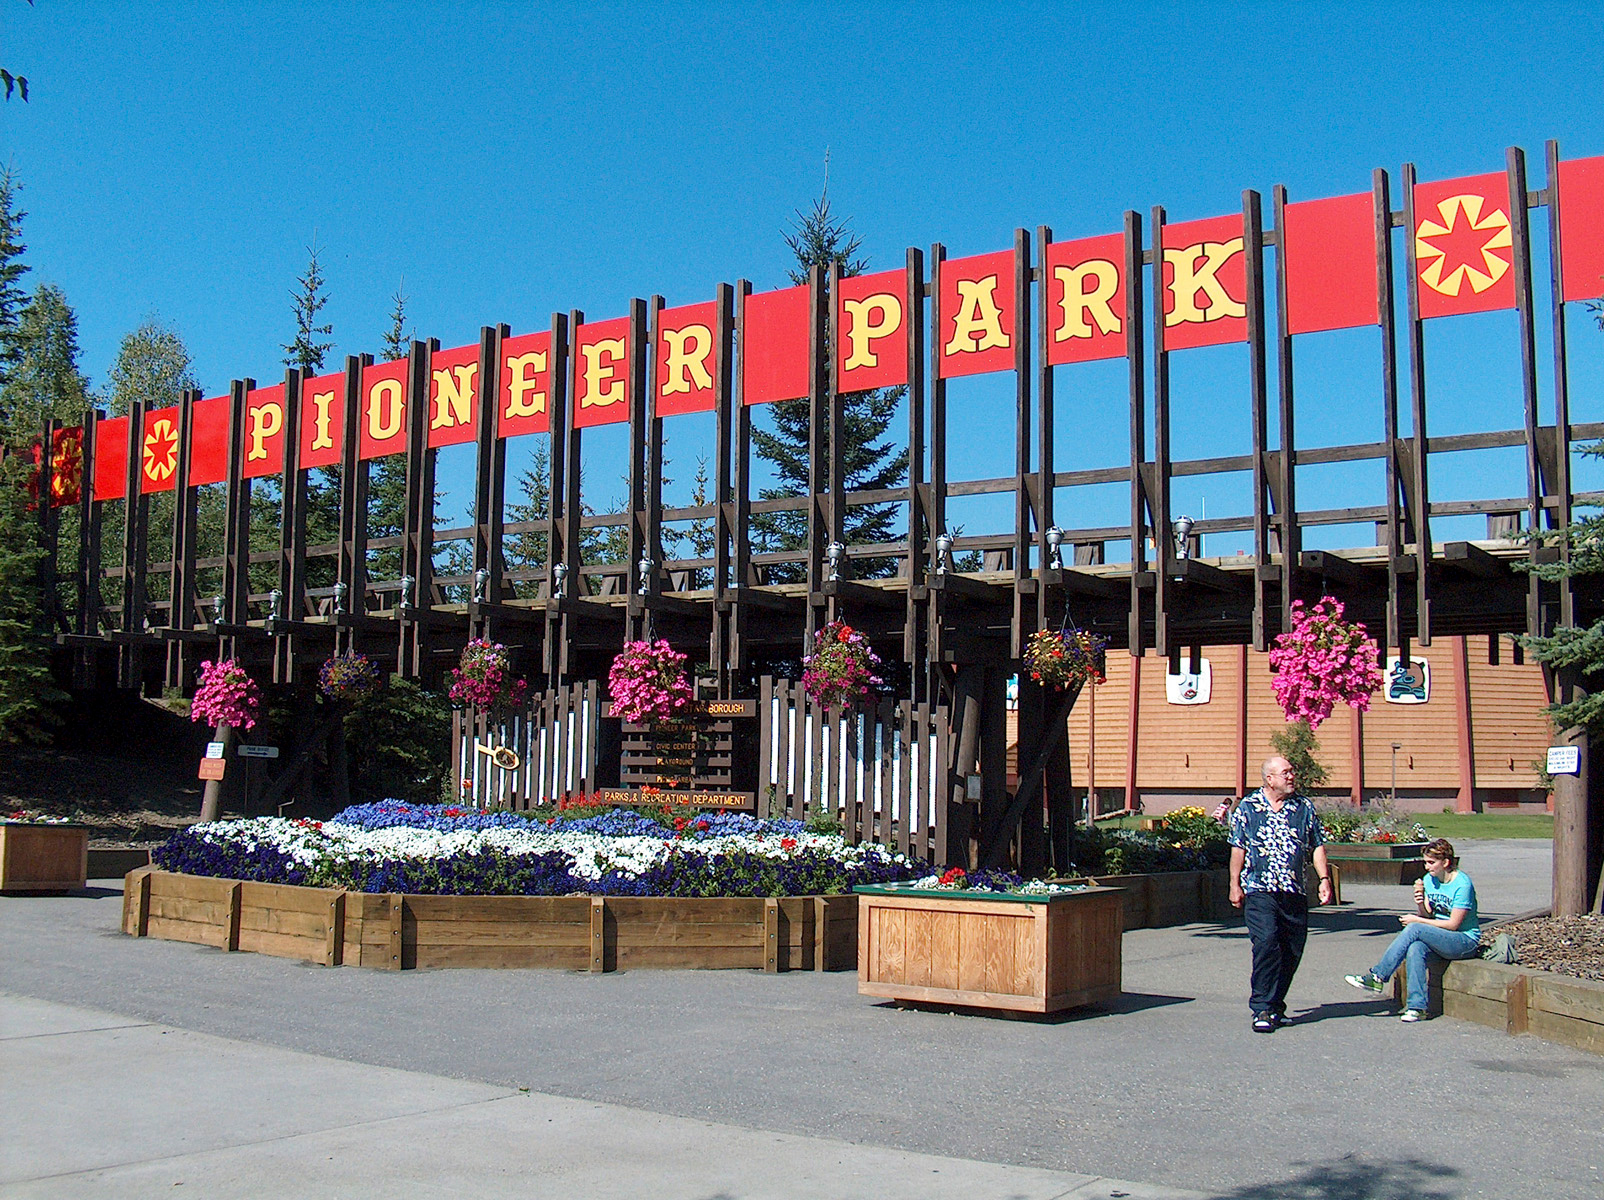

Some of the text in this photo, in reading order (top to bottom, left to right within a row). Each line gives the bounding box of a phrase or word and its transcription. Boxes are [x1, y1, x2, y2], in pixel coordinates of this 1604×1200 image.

[247, 238, 1246, 461] PIONEER PARK
[708, 704, 744, 713] BOROUGH
[641, 792, 690, 804] RECREATION
[692, 794, 746, 805] DEPARTMENT
